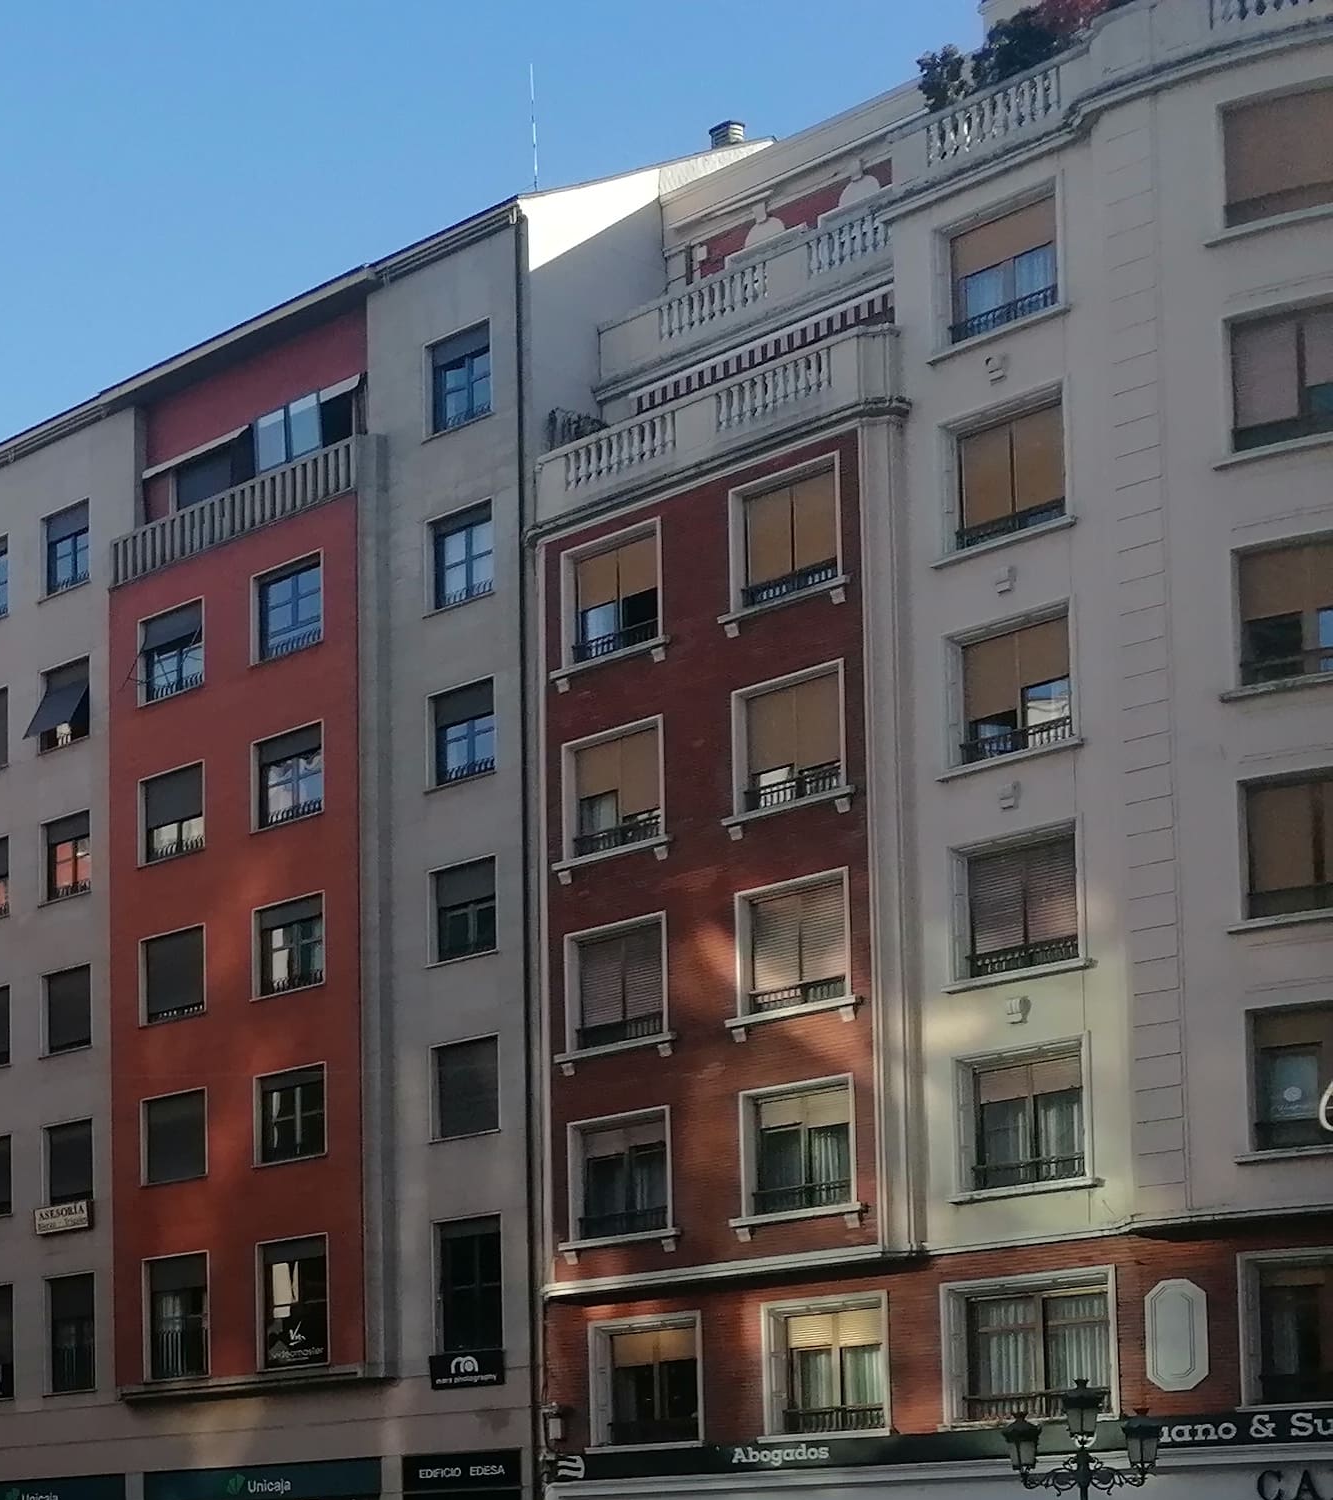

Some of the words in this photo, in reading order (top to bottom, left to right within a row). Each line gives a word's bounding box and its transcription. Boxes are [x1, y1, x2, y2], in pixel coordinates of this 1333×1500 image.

[1249, 1414, 1276, 1438] &
[1290, 1413, 1333, 1437] Su
[731, 1443, 830, 1467] Abogados
[418, 1467, 462, 1479] EDIFICIO
[469, 1464, 506, 1477] EDESA
[248, 1478, 292, 1497] Unicaja
